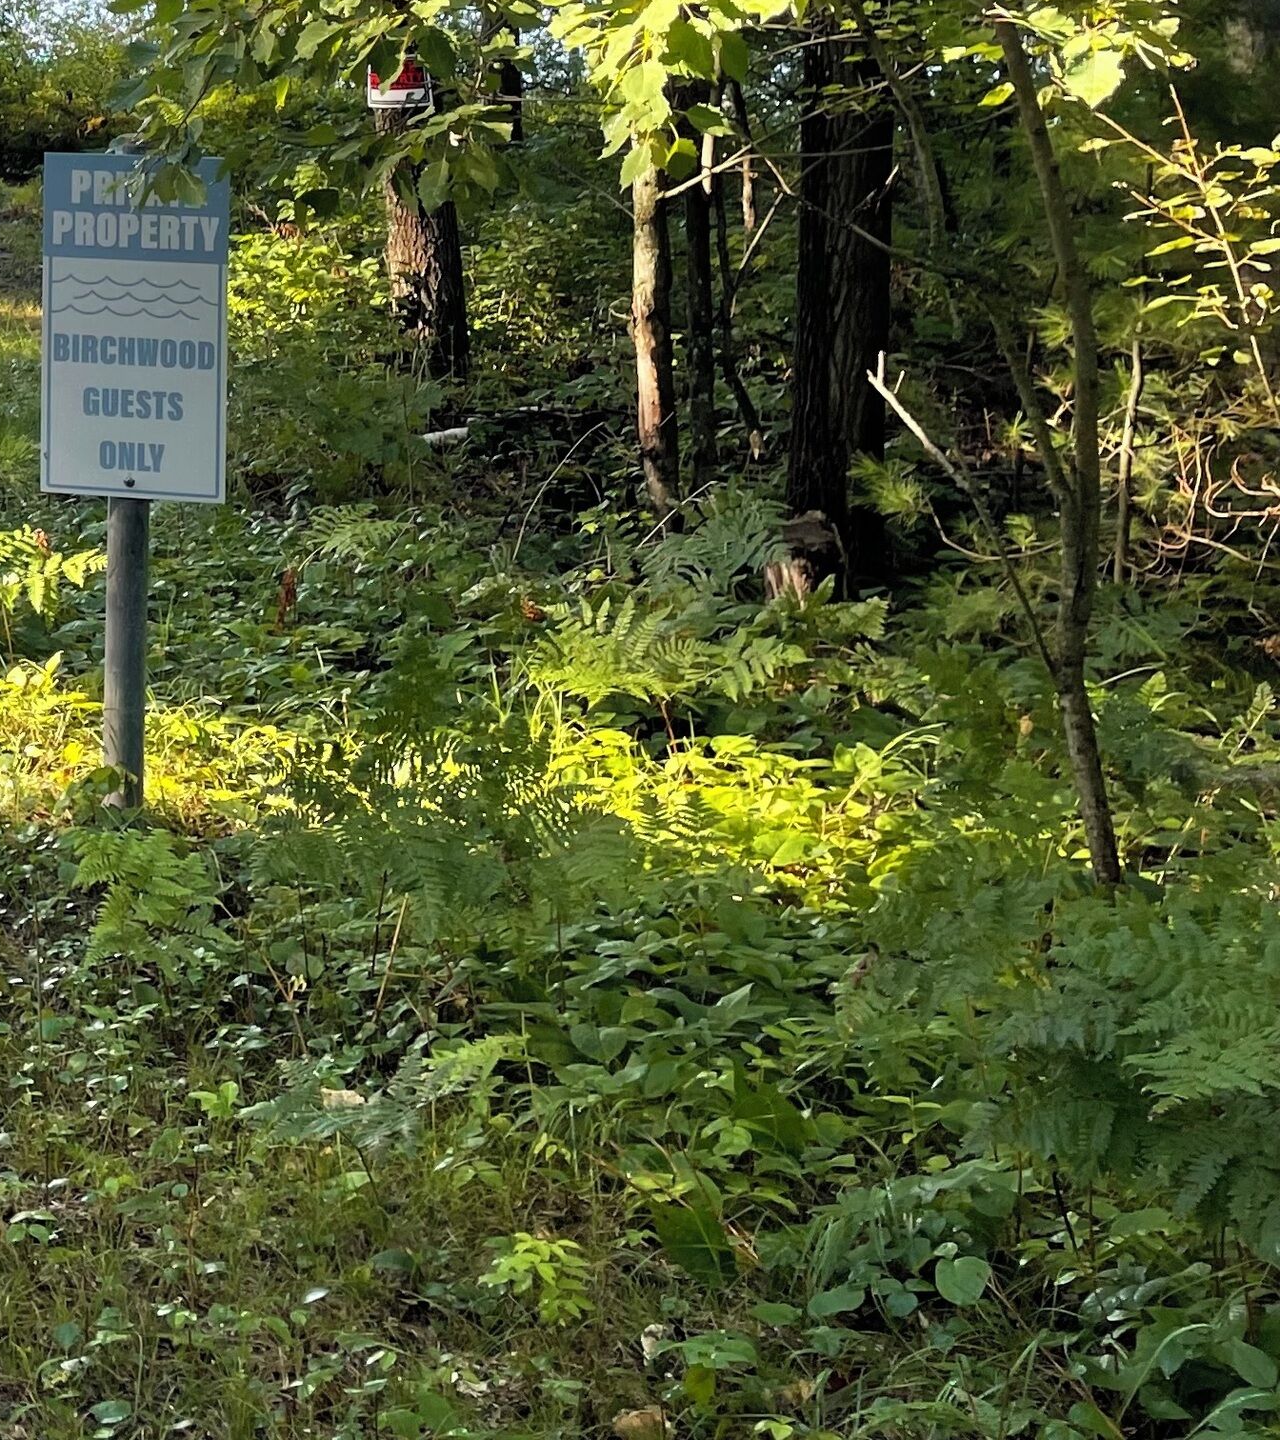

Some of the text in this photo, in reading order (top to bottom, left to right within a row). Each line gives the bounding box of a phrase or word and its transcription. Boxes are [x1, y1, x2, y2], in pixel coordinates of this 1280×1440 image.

[51, 210, 220, 252] PROPERTY
[53, 333, 216, 371] BIRCHWOOD
[82, 386, 184, 422] GUESTS
[98, 439, 166, 474] ONLY
